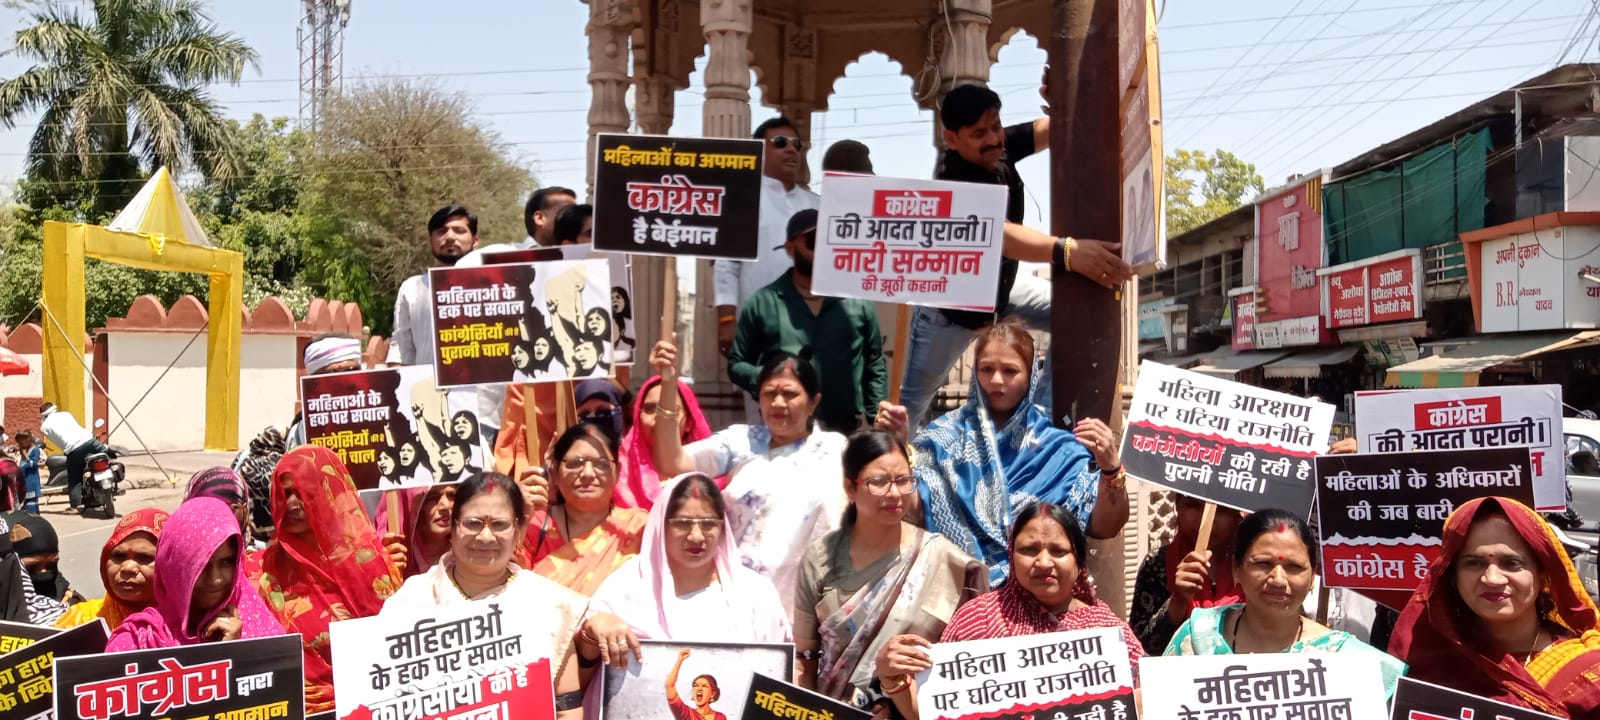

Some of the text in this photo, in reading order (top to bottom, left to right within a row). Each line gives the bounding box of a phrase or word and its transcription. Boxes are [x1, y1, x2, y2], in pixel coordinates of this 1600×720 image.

[603, 145, 757, 170] महिलाओं का अपमान
[626, 174, 725, 216] कांग्रेस
[885, 190, 940, 216] कांग्रेस
[633, 215, 718, 247] है बेईमान
[835, 213, 987, 248] की आदत पुरानी।
[832, 242, 984, 276] नारी सम्मान
[1496, 242, 1540, 268] अपनी दुकान
[862, 275, 948, 296] की झूठी कहानी
[1379, 268, 1403, 287] अशोक
[436, 283, 516, 304] महिलाओं के
[1496, 281, 1518, 307] B.R.
[1535, 299, 1553, 311] यादव
[437, 300, 524, 319] हक पर सवाल
[439, 322, 503, 343] कांग्रेसियों
[440, 342, 510, 365] पुरानी चाल
[307, 388, 382, 411] महिलाओं के
[1158, 378, 1313, 422] महिला आरक्षण
[309, 406, 390, 427] हक पर सवाल
[1145, 402, 1316, 447] पर घटिया राजनीति
[1428, 401, 1488, 427] कांग्रेस
[1375, 428, 1405, 453] की
[1411, 430, 1469, 451] आदत
[349, 449, 376, 464] चाल
[1230, 452, 1256, 473] की
[1261, 458, 1292, 478] रही
[1296, 460, 1312, 481] है
[1165, 461, 1267, 494] पुरानी नीति।
[1324, 468, 1401, 491] महिलाओं
[1406, 466, 1428, 490] के
[1435, 464, 1523, 489] अधिकारों
[1346, 498, 1454, 521] की जब बारी
[1333, 553, 1430, 580] कांग्रेस है
[385, 603, 503, 660] महिलाओं
[369, 634, 523, 691] के हक पर सवाल
[936, 635, 1104, 681] महिला आरक्षण
[74, 657, 274, 720] कांग्रेस द्वारा
[488, 665, 513, 695] की
[513, 660, 529, 688] है
[932, 660, 1117, 711] पर घटिया राजनीति
[1193, 658, 1327, 705] महिलाओं
[1111, 700, 1127, 720] है
[1282, 698, 1352, 720] सवाल
